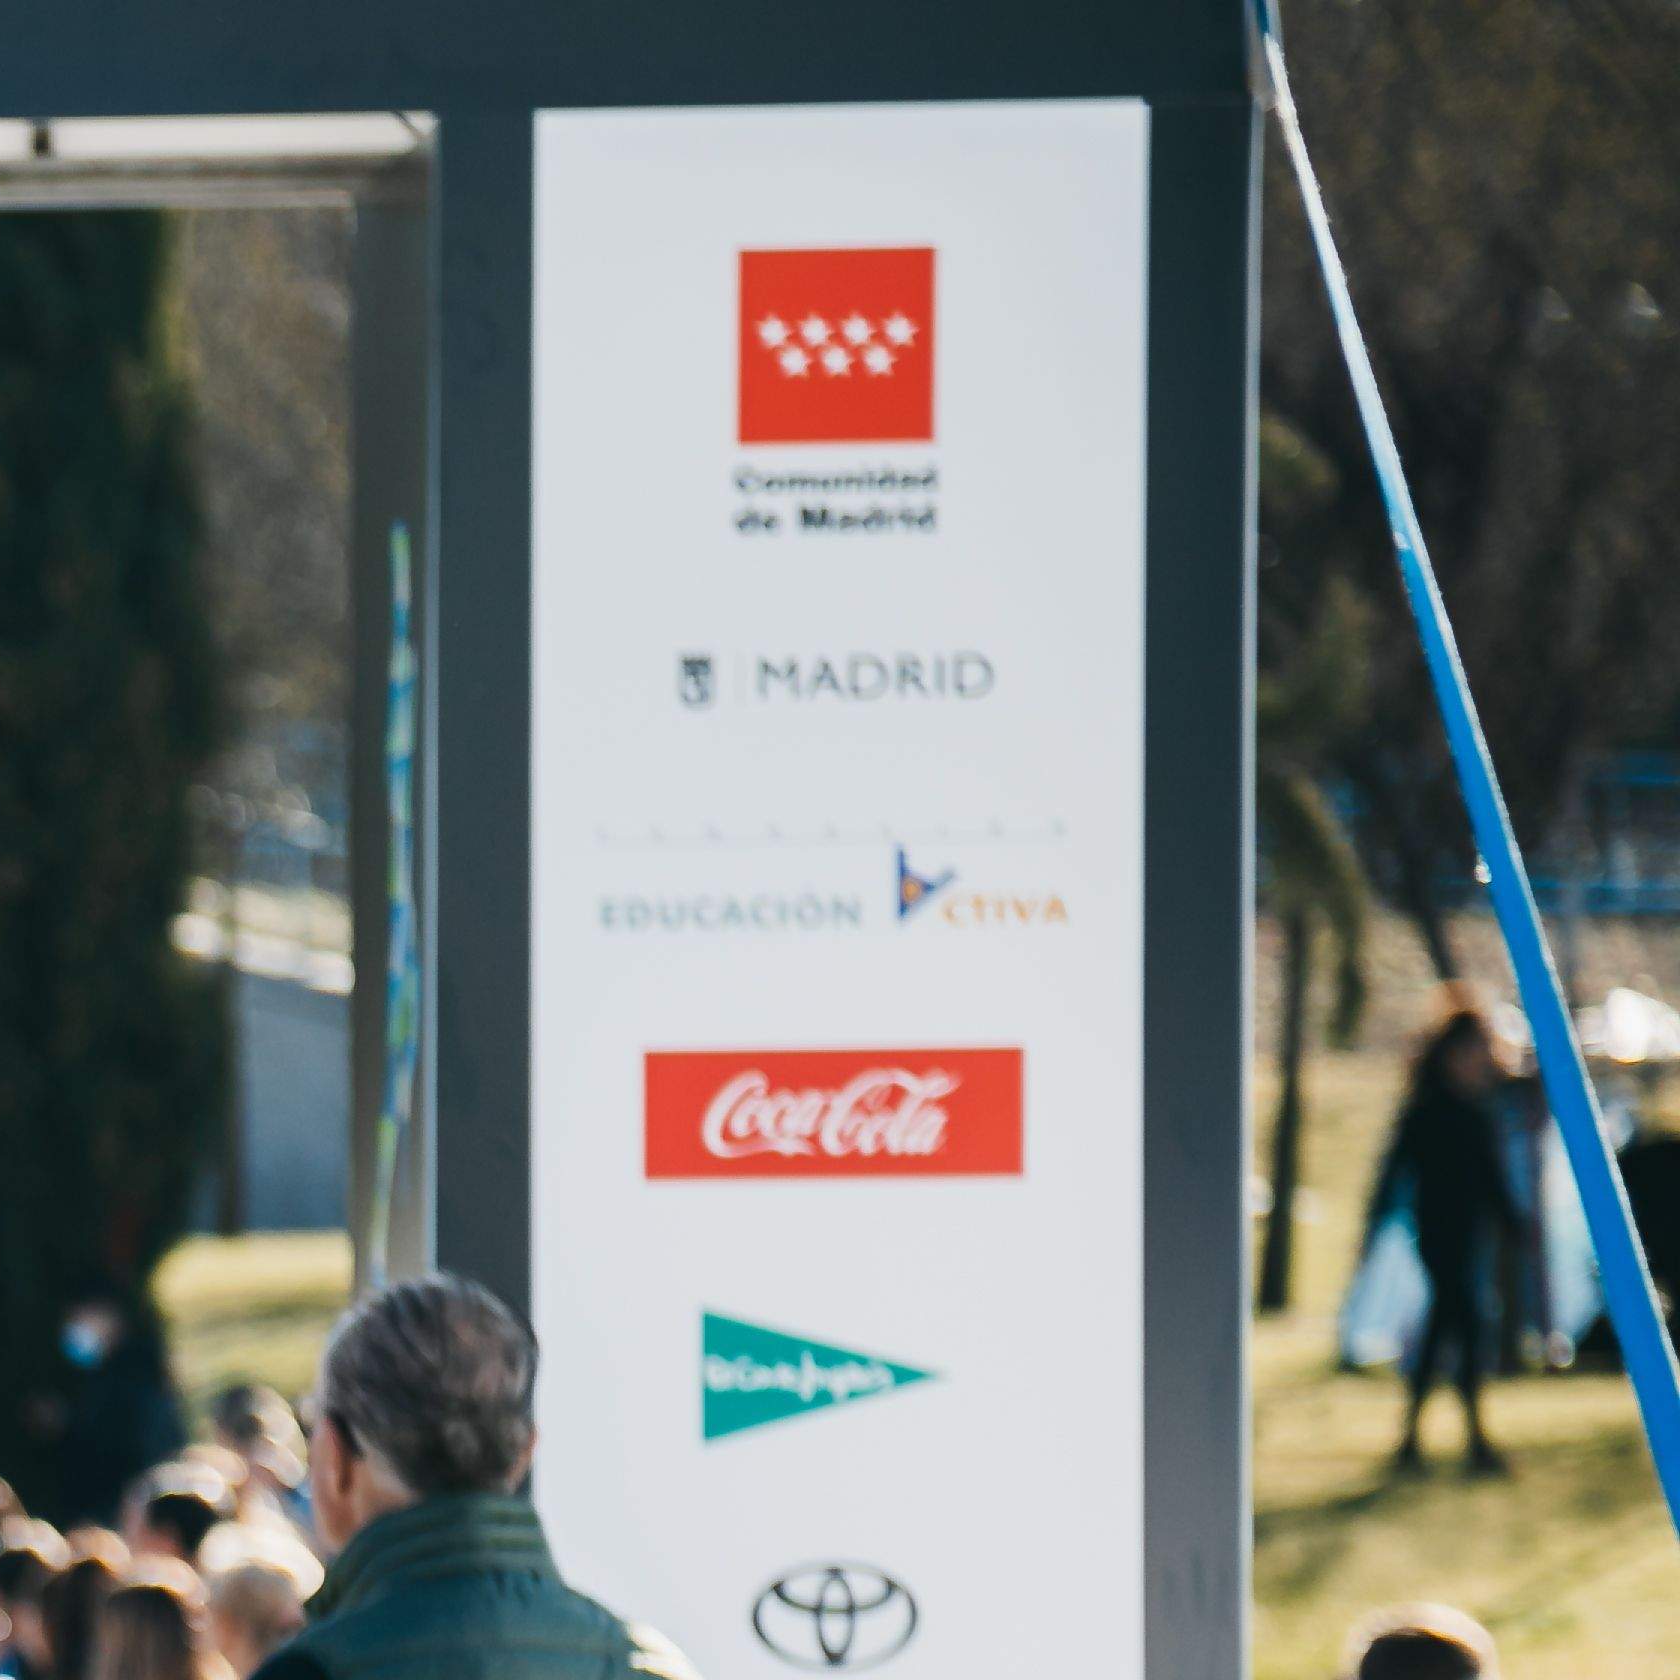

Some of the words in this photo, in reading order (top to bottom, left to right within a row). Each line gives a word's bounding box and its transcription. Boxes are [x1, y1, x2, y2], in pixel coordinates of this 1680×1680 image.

[798, 507, 938, 534] Madrid
[755, 652, 997, 702] MADRID
[599, 891, 865, 932] EDUCACIÓN
